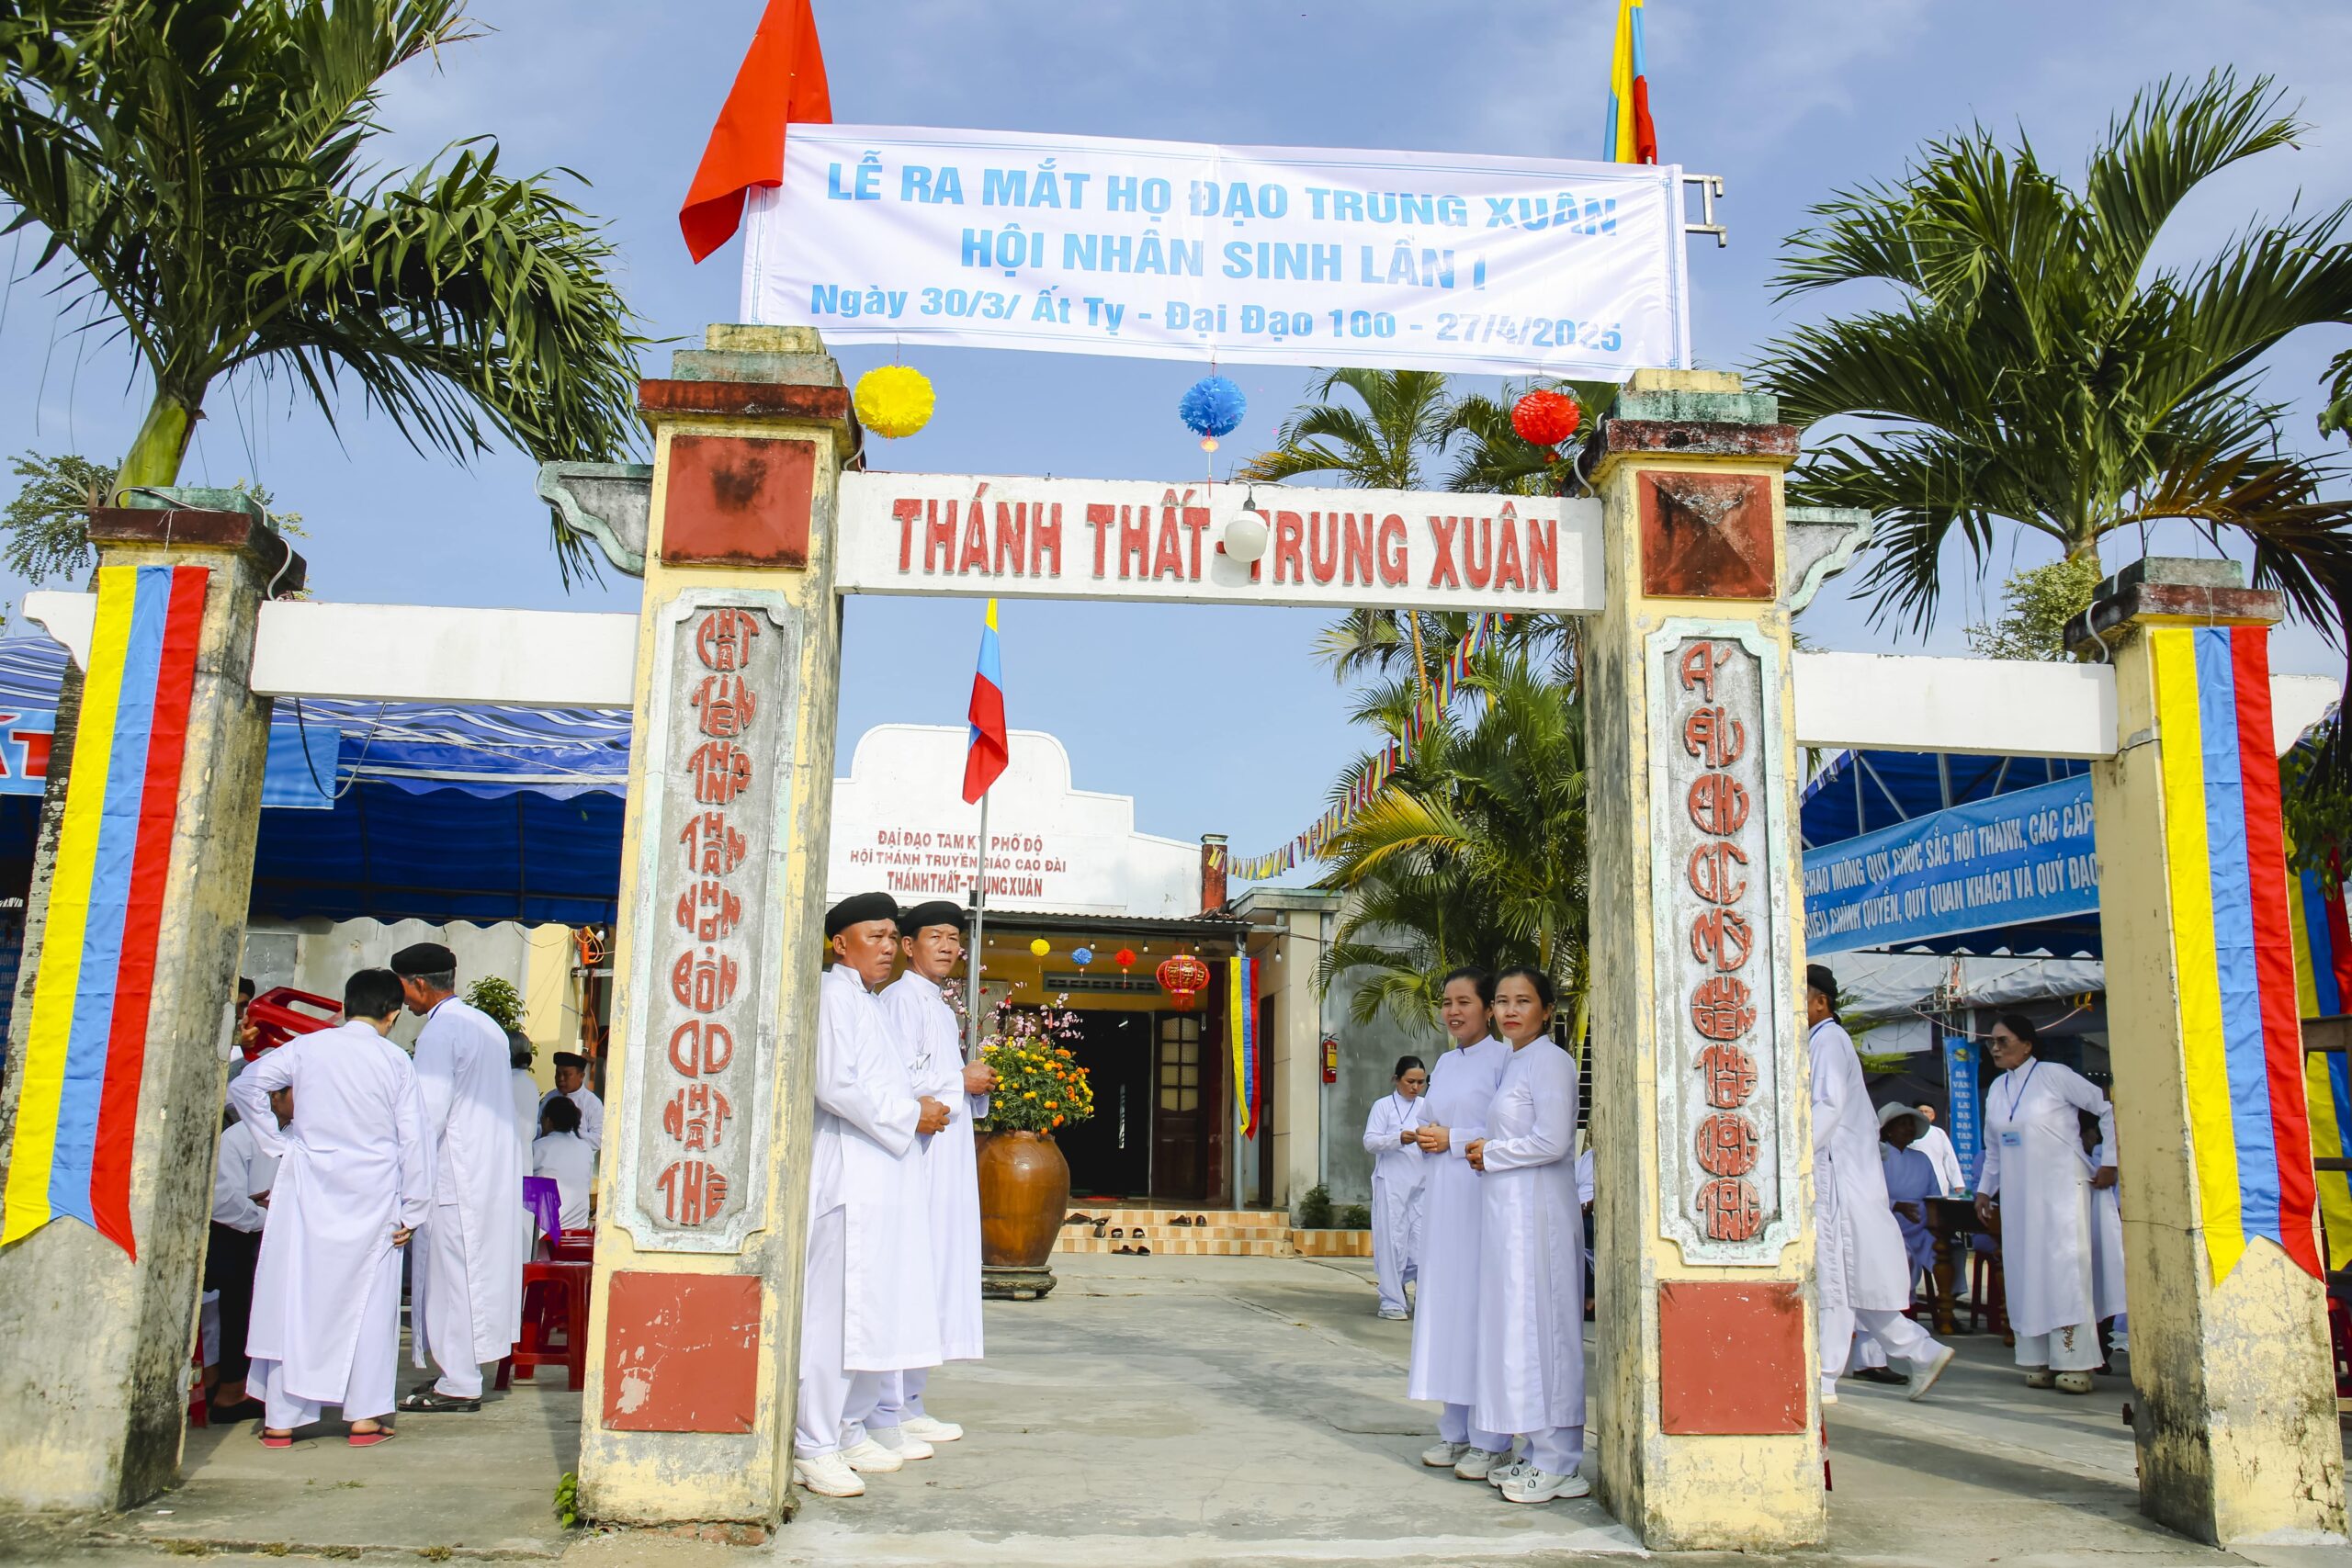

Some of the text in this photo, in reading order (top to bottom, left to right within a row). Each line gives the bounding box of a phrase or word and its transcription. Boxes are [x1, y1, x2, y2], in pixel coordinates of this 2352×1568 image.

[827, 150, 1617, 236] LỄ RA MẮT HỌ ĐẠO TRUNG XUÂN
[961, 222, 1045, 277] HỘI
[1062, 229, 1204, 276] NHÂN
[1222, 241, 1342, 282] SINH
[1361, 234, 1455, 289] LẦN
[810, 284, 908, 319] Ngày
[920, 287, 1021, 320] 30/3/
[1030, 285, 1071, 323] Ất
[1083, 298, 1125, 335] Tỵ
[1165, 301, 1227, 338] Đại
[1240, 304, 1313, 342] Đạo
[1329, 309, 1396, 339] 100
[1436, 313, 1623, 353] 27/4/2025
[892, 482, 1062, 577] THÁNH
[1086, 489, 1211, 581] THẤT
[1427, 501, 1558, 592] XUÂN
[851, 849, 873, 866] HỘI
[876, 850, 921, 865] THÁNH
[1015, 858, 1041, 872] CAO
[1045, 856, 1066, 873] ĐÀI
[877, 828, 901, 849] ĐẠI
[904, 831, 932, 850] ĐẠO
[937, 833, 964, 849] TAM
[1023, 835, 1043, 856] ĐỘ
[1926, 825, 1950, 869] SẮC
[1953, 825, 1975, 867] HỘI
[1978, 817, 2028, 856] THÁNH,
[2029, 805, 2059, 845] CÁC
[2063, 792, 2095, 839] CẤP
[888, 867, 929, 892] THÁNH
[1009, 873, 1043, 897] XUÂN
[1904, 881, 1927, 922] QUÝ
[1930, 880, 1964, 917] QUAN
[1966, 867, 2011, 908] KHÁCH
[2014, 860, 2034, 899] VÀ
[2036, 852, 2064, 898] QUÝ
[2068, 852, 2098, 896] ĐẠO
